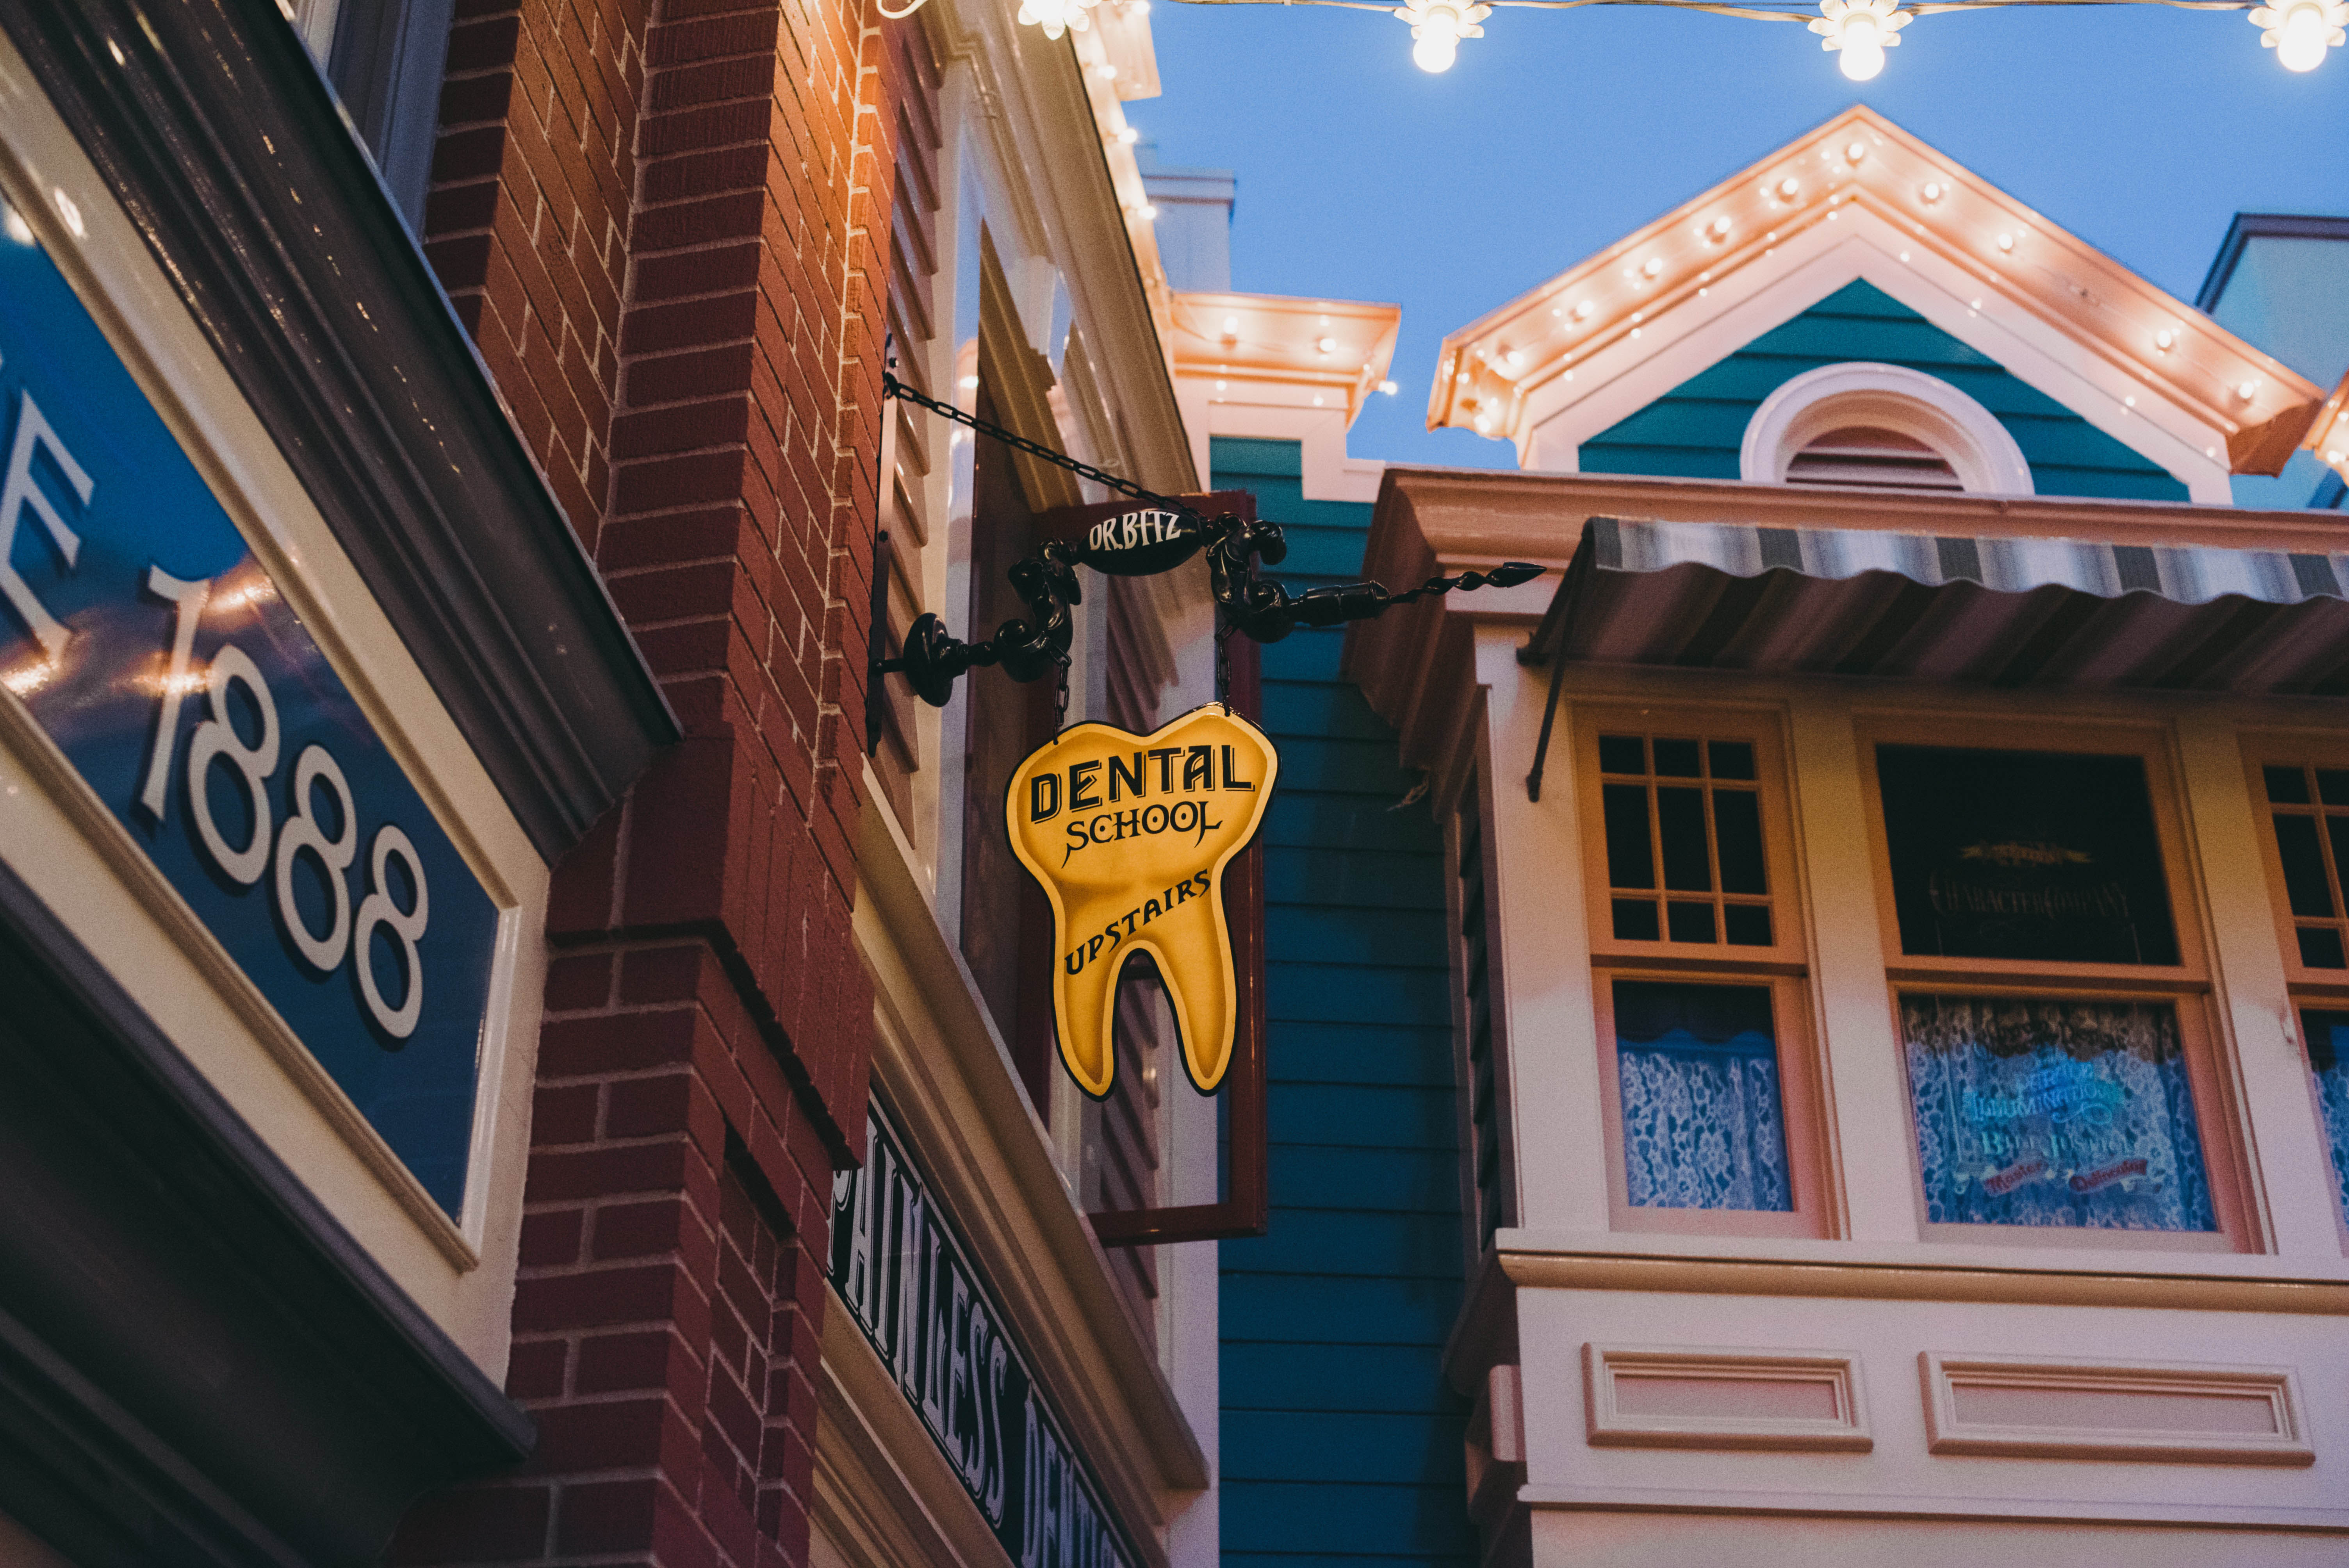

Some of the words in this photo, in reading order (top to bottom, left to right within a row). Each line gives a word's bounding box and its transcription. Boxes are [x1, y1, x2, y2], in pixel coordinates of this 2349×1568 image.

[1122, 511, 1182, 550] BITZ
[141, 563, 429, 1039] 1888
[1030, 745, 1255, 824] DENTAL
[1061, 801, 1223, 869] SCHOOL
[1064, 868, 1211, 975] UPSTAIRS
